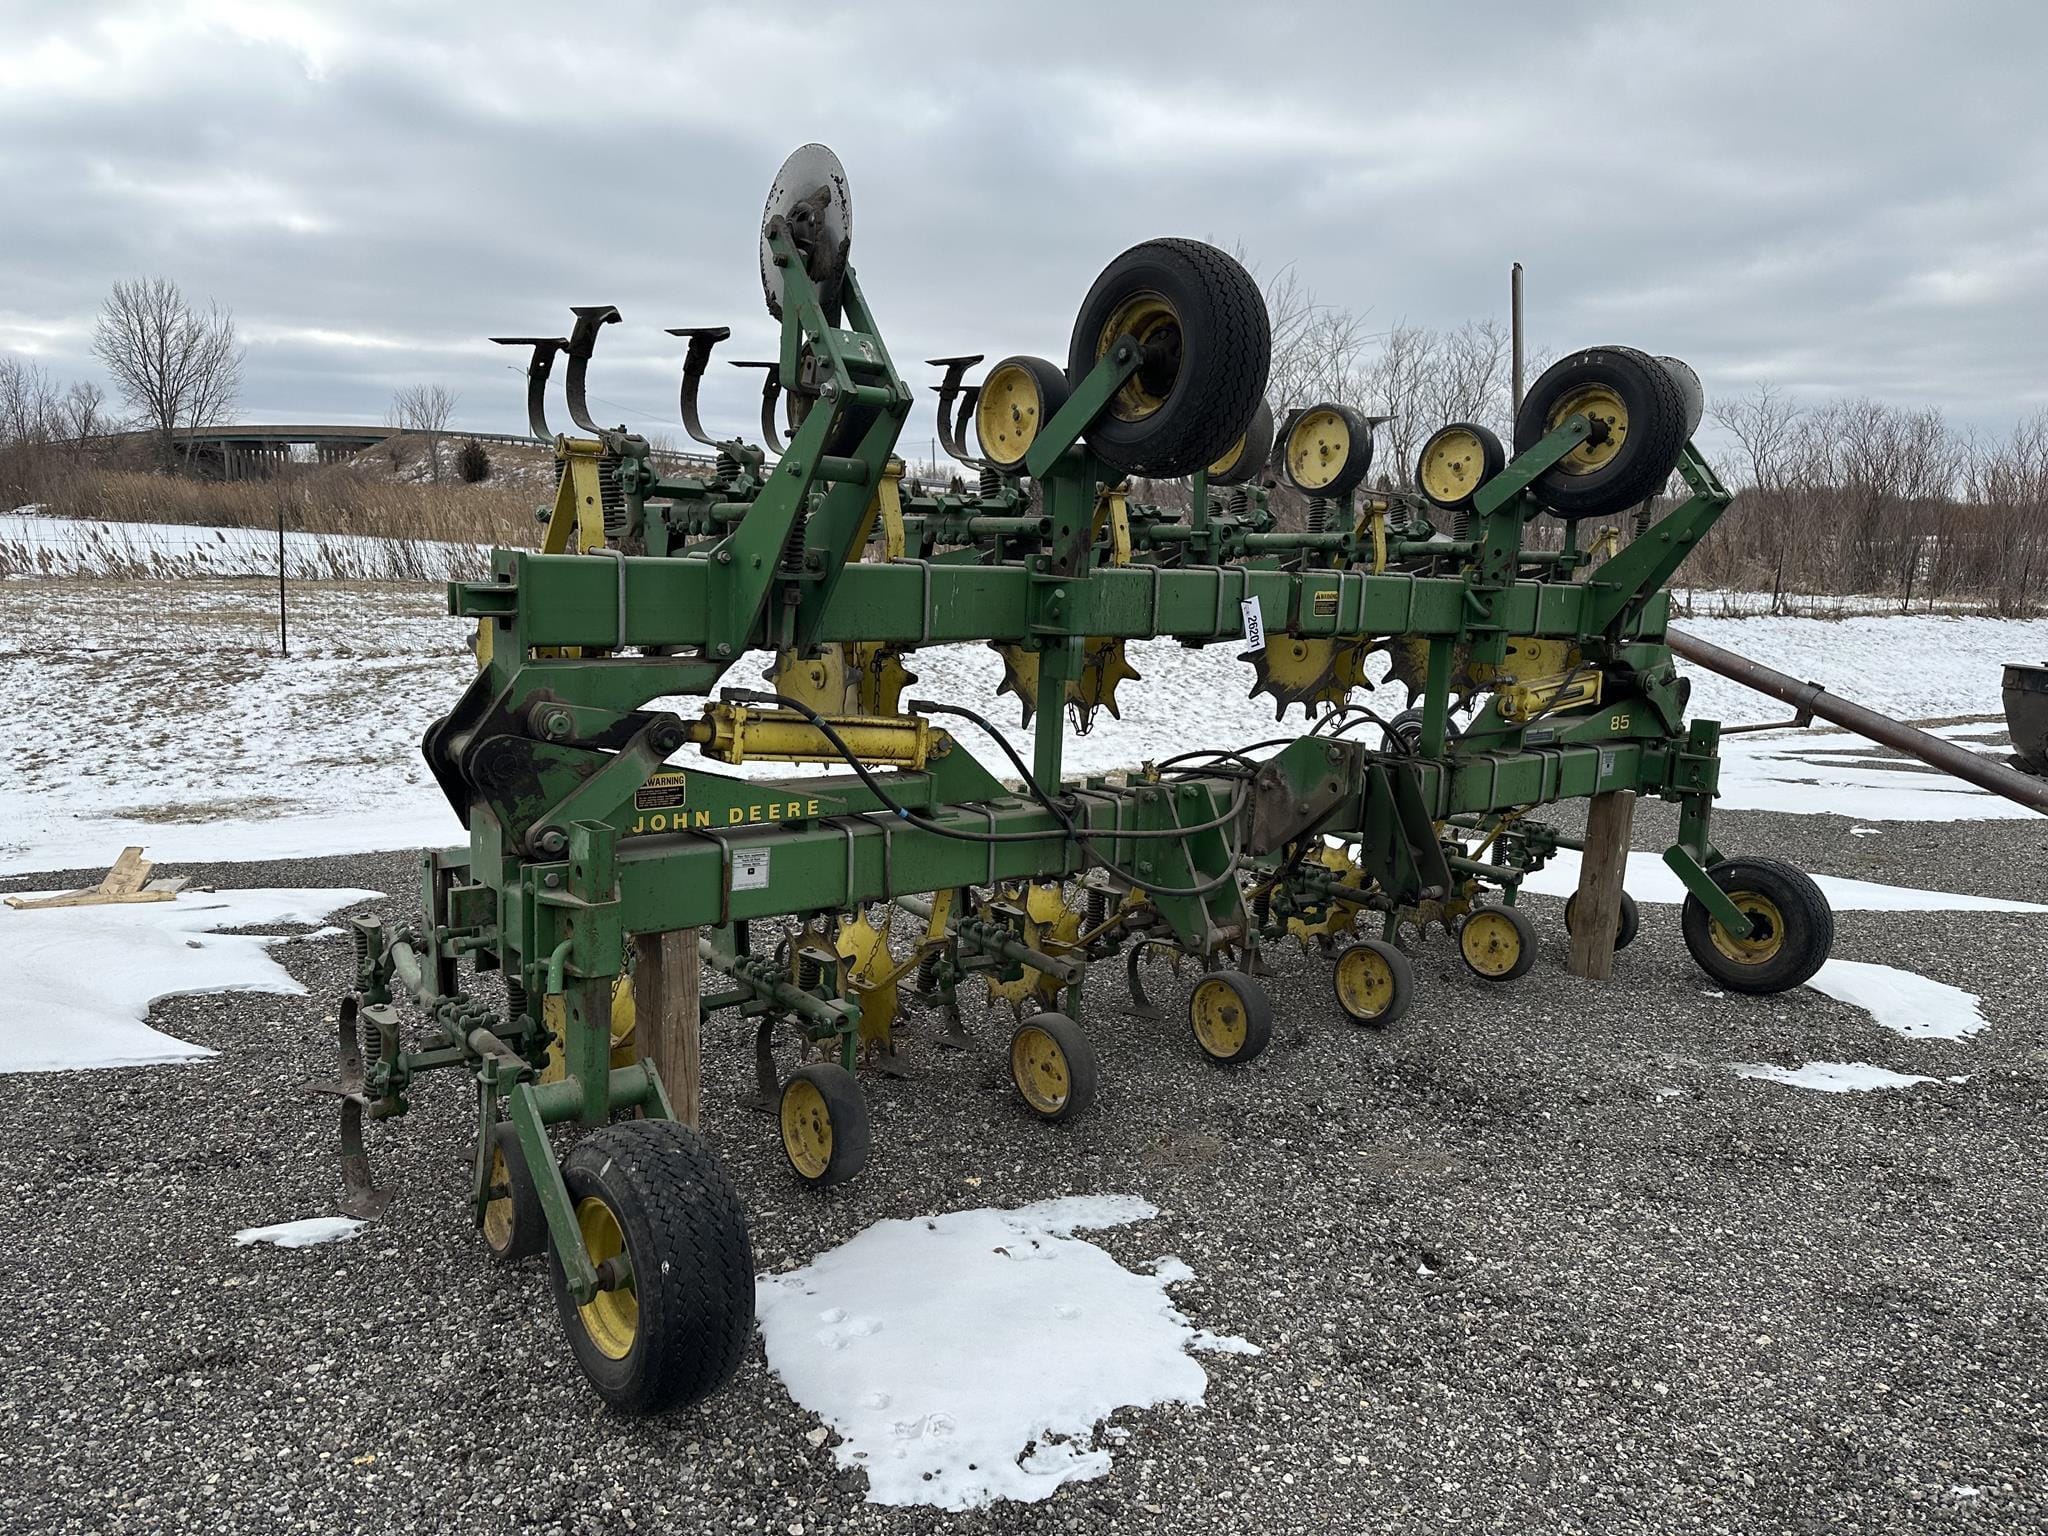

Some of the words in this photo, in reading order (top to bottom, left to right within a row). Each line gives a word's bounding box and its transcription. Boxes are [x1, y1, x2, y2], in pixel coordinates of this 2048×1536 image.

[1248, 615, 1260, 648] 26201
[1610, 715, 1630, 731] 85
[647, 776, 684, 786] WARNING
[632, 810, 710, 833] JOHN
[729, 799, 820, 824] DEERE
